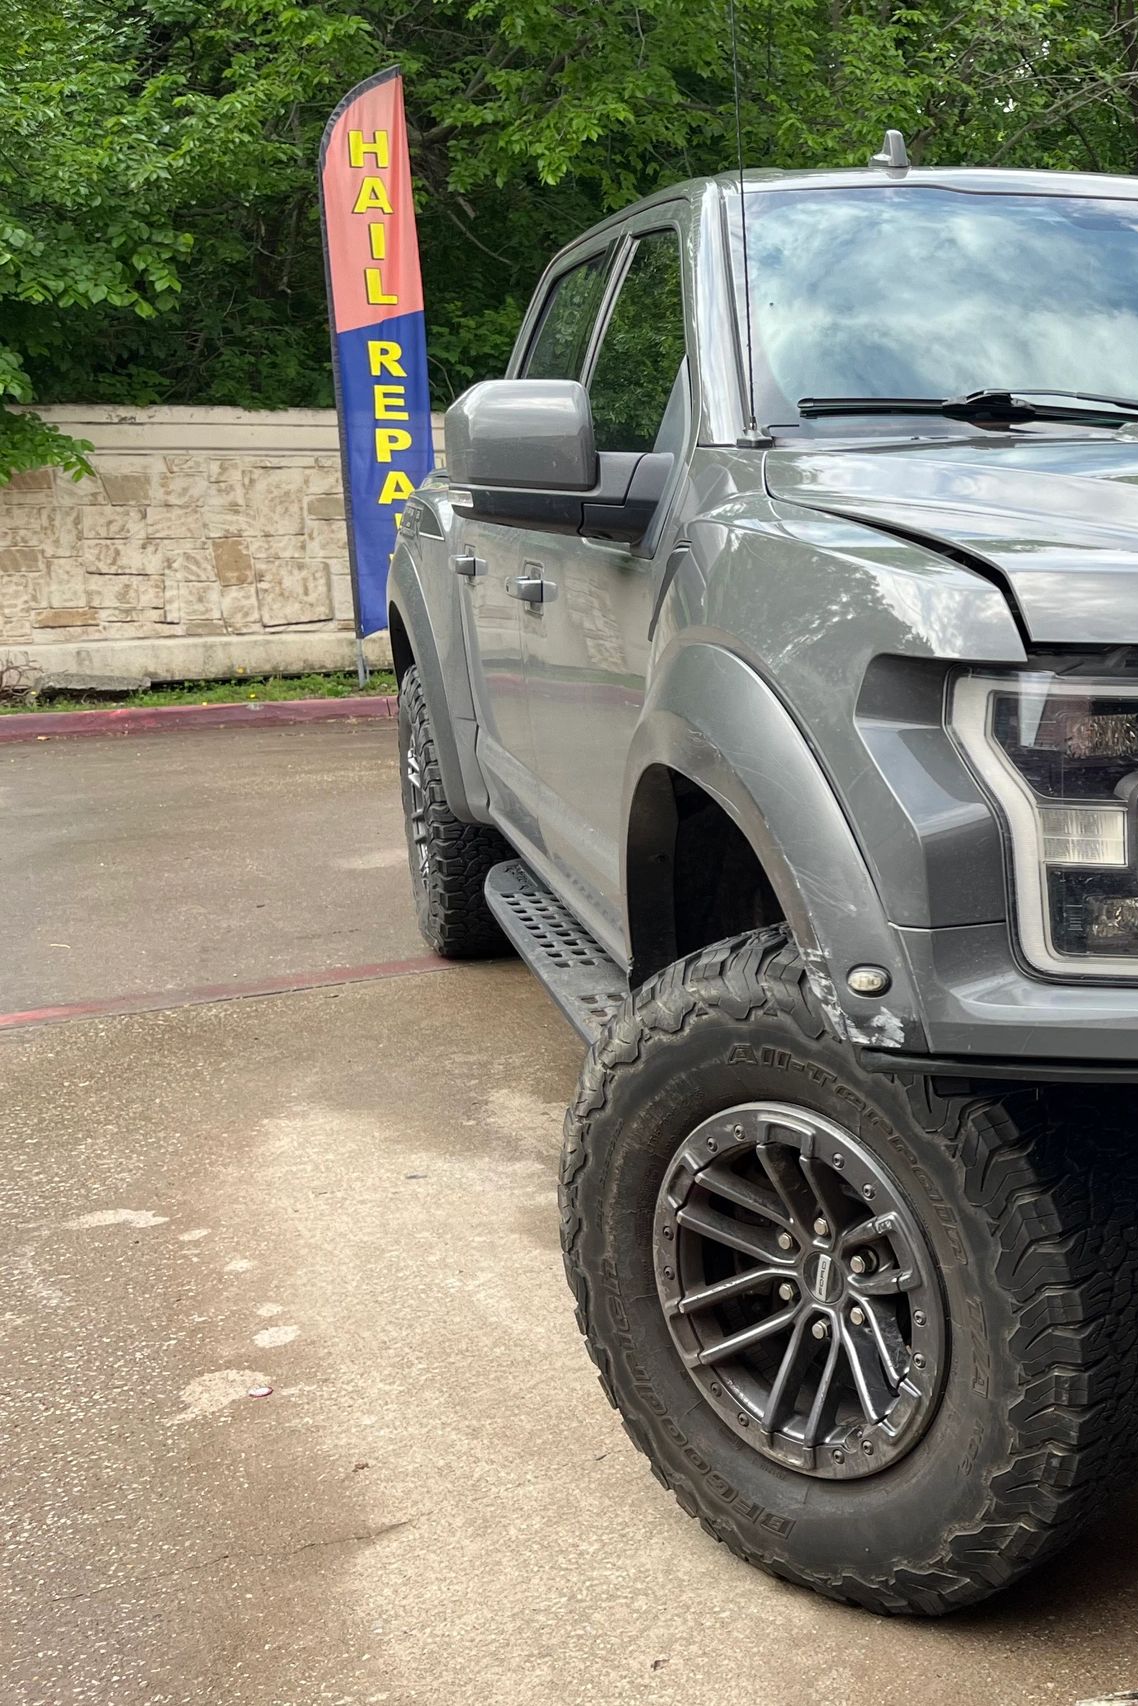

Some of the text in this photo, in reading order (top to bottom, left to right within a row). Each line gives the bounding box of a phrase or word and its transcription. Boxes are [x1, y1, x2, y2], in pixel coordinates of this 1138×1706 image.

[347, 129, 416, 564] HAIL REPA
[818, 1259, 828, 1296] FORD
